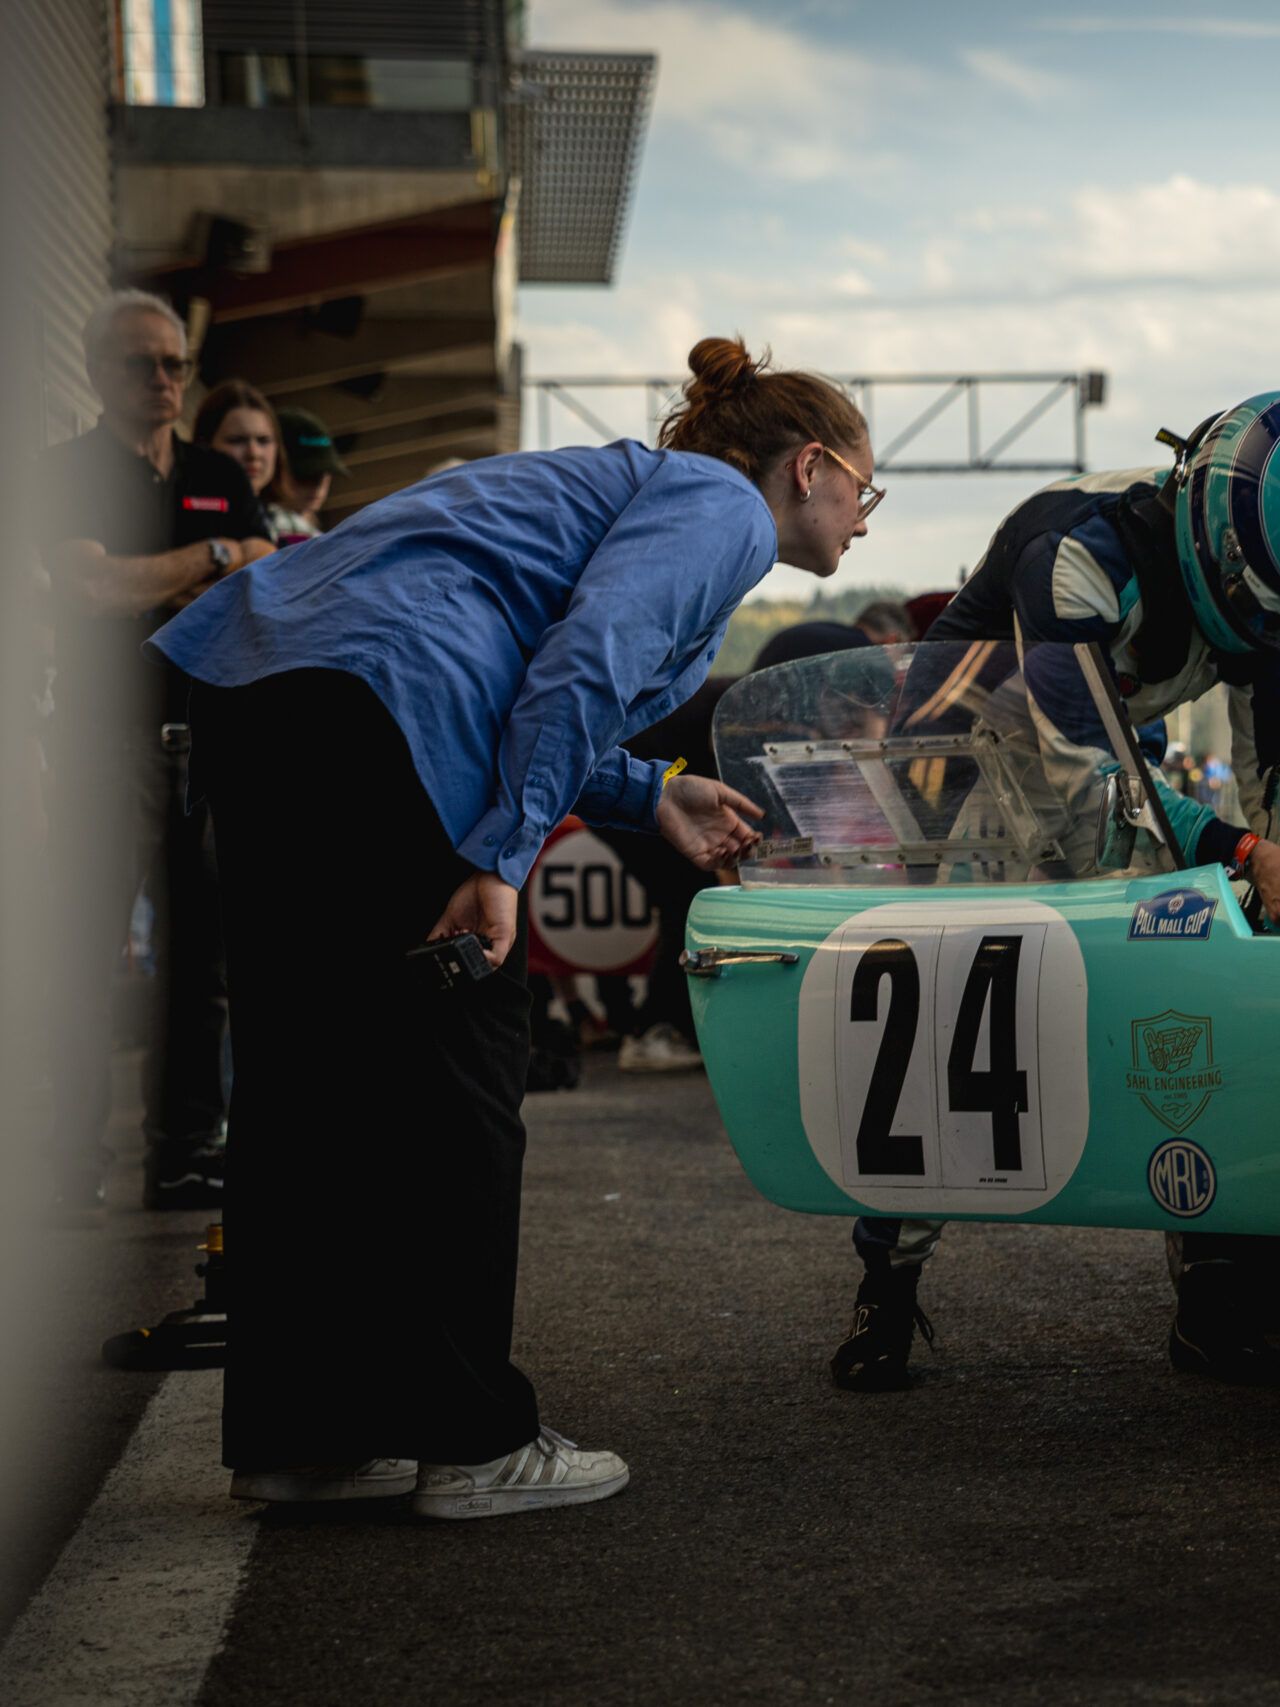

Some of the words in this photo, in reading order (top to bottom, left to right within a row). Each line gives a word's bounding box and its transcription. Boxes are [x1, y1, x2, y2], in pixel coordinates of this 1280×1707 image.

[1133, 906, 1157, 935] PALL
[1157, 917, 1183, 934] MALL
[1184, 906, 1210, 934] CUP
[850, 935, 1028, 1175] 24
[1126, 1073, 1151, 1089] SAHL
[1154, 1070, 1222, 1090] ENGINEERING
[1155, 1148, 1206, 1209] MRL
